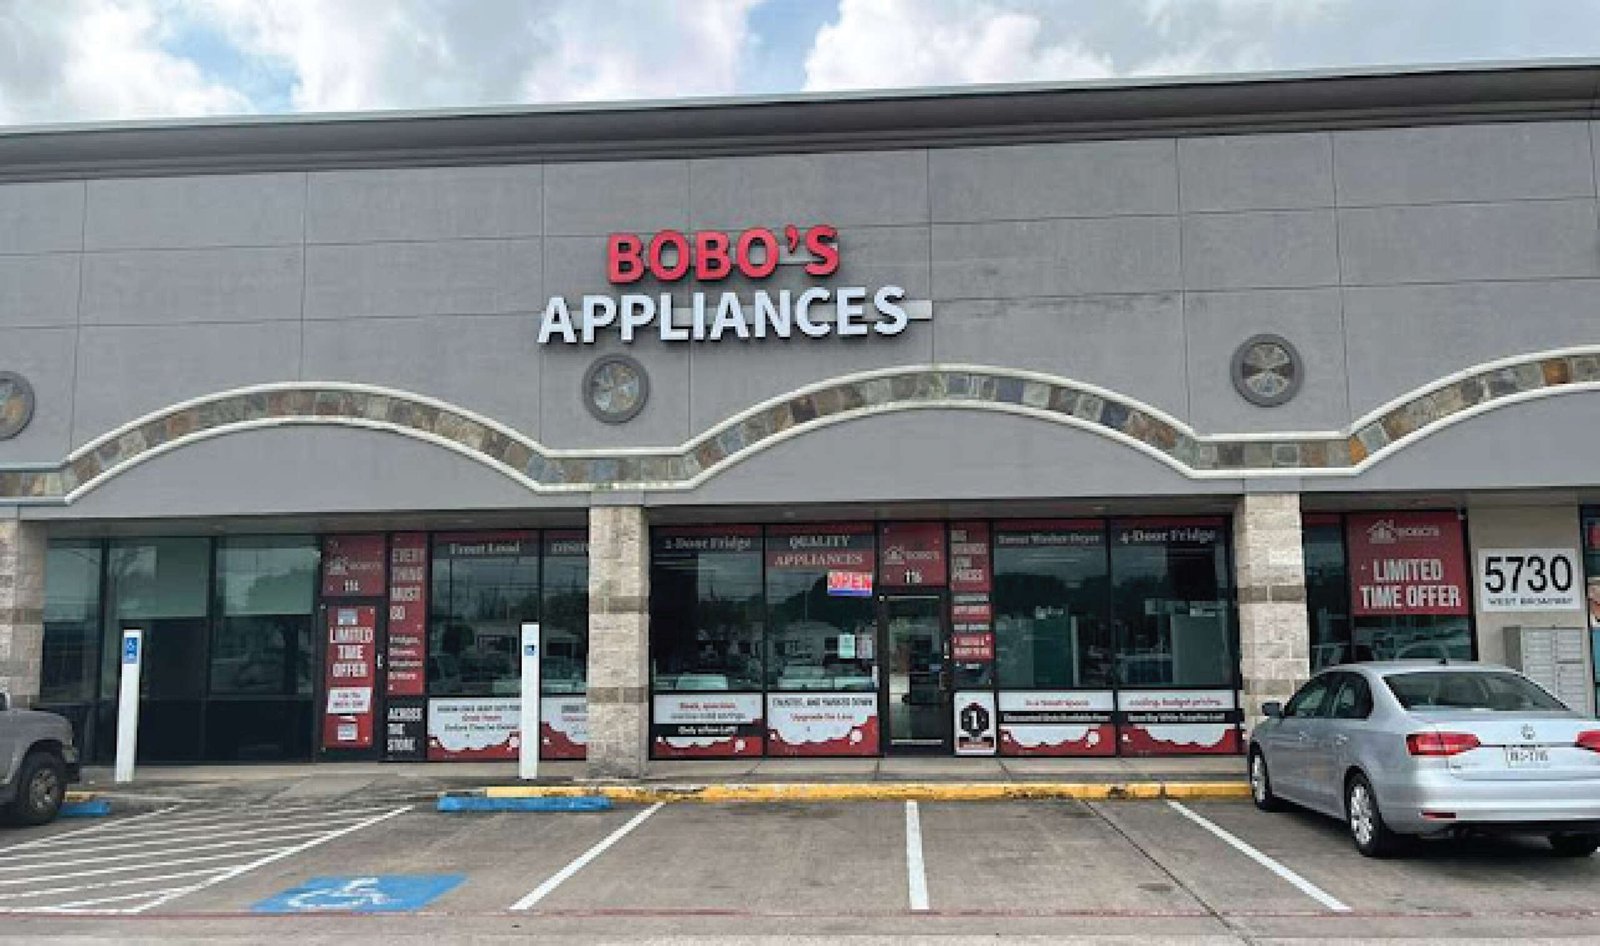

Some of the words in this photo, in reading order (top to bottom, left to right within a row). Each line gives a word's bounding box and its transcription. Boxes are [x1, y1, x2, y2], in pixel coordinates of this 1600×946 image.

[607, 225, 840, 284] BOBO'S
[537, 286, 909, 344] APPLIANCES
[789, 535, 851, 548] QUALITY
[775, 553, 864, 567] APPLIANCES
[1373, 559, 1442, 581] LIMITED
[1484, 556, 1573, 594] 5730
[829, 573, 872, 589] OPEN
[1360, 586, 1402, 609] TIME
[1406, 585, 1462, 607] OFFER
[1488, 597, 1516, 606] WEST
[329, 626, 374, 644] LIMITED
[337, 644, 364, 659] TIME
[332, 663, 368, 678] OFFER
[388, 706, 423, 722] ACROSS
